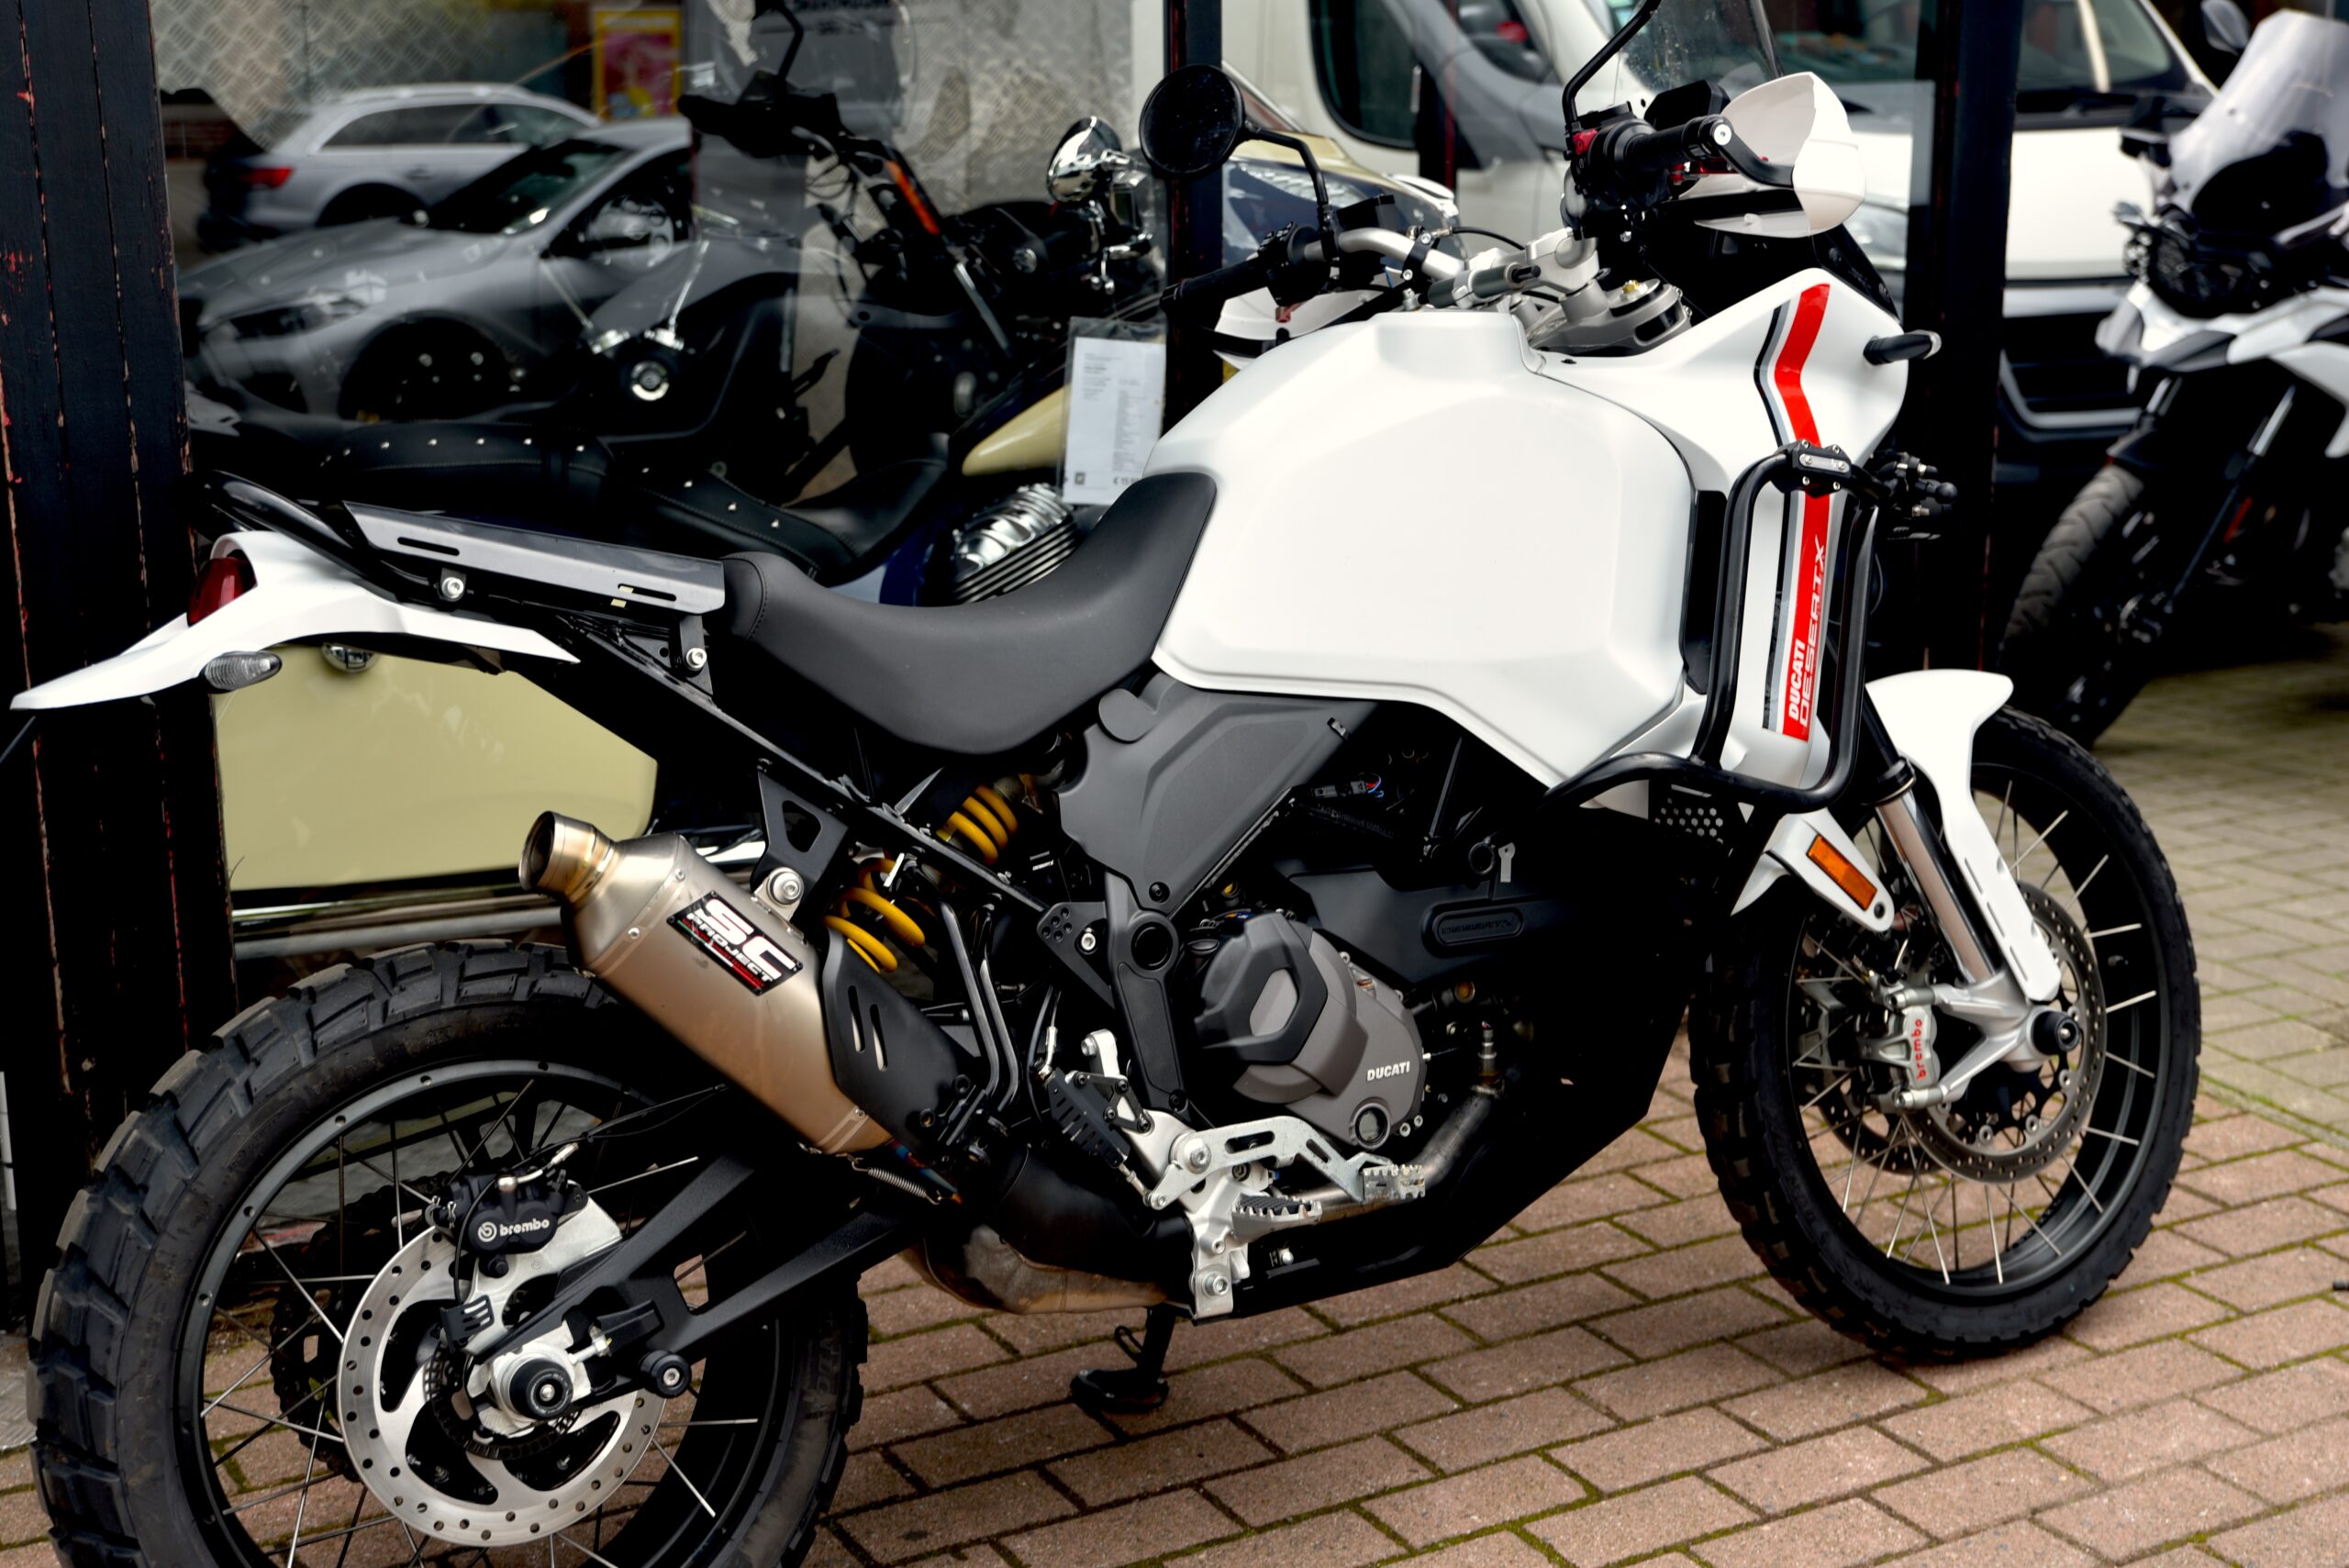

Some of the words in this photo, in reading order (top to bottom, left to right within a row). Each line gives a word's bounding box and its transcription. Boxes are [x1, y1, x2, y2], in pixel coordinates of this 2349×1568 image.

[1788, 639, 1806, 722] DUCATI
[686, 912, 774, 983] PROJECT
[695, 898, 796, 980] SC
[1367, 1061, 1410, 1082] DUCATI
[1911, 1018, 1926, 1081] brembo
[499, 1218, 550, 1237] brembo
